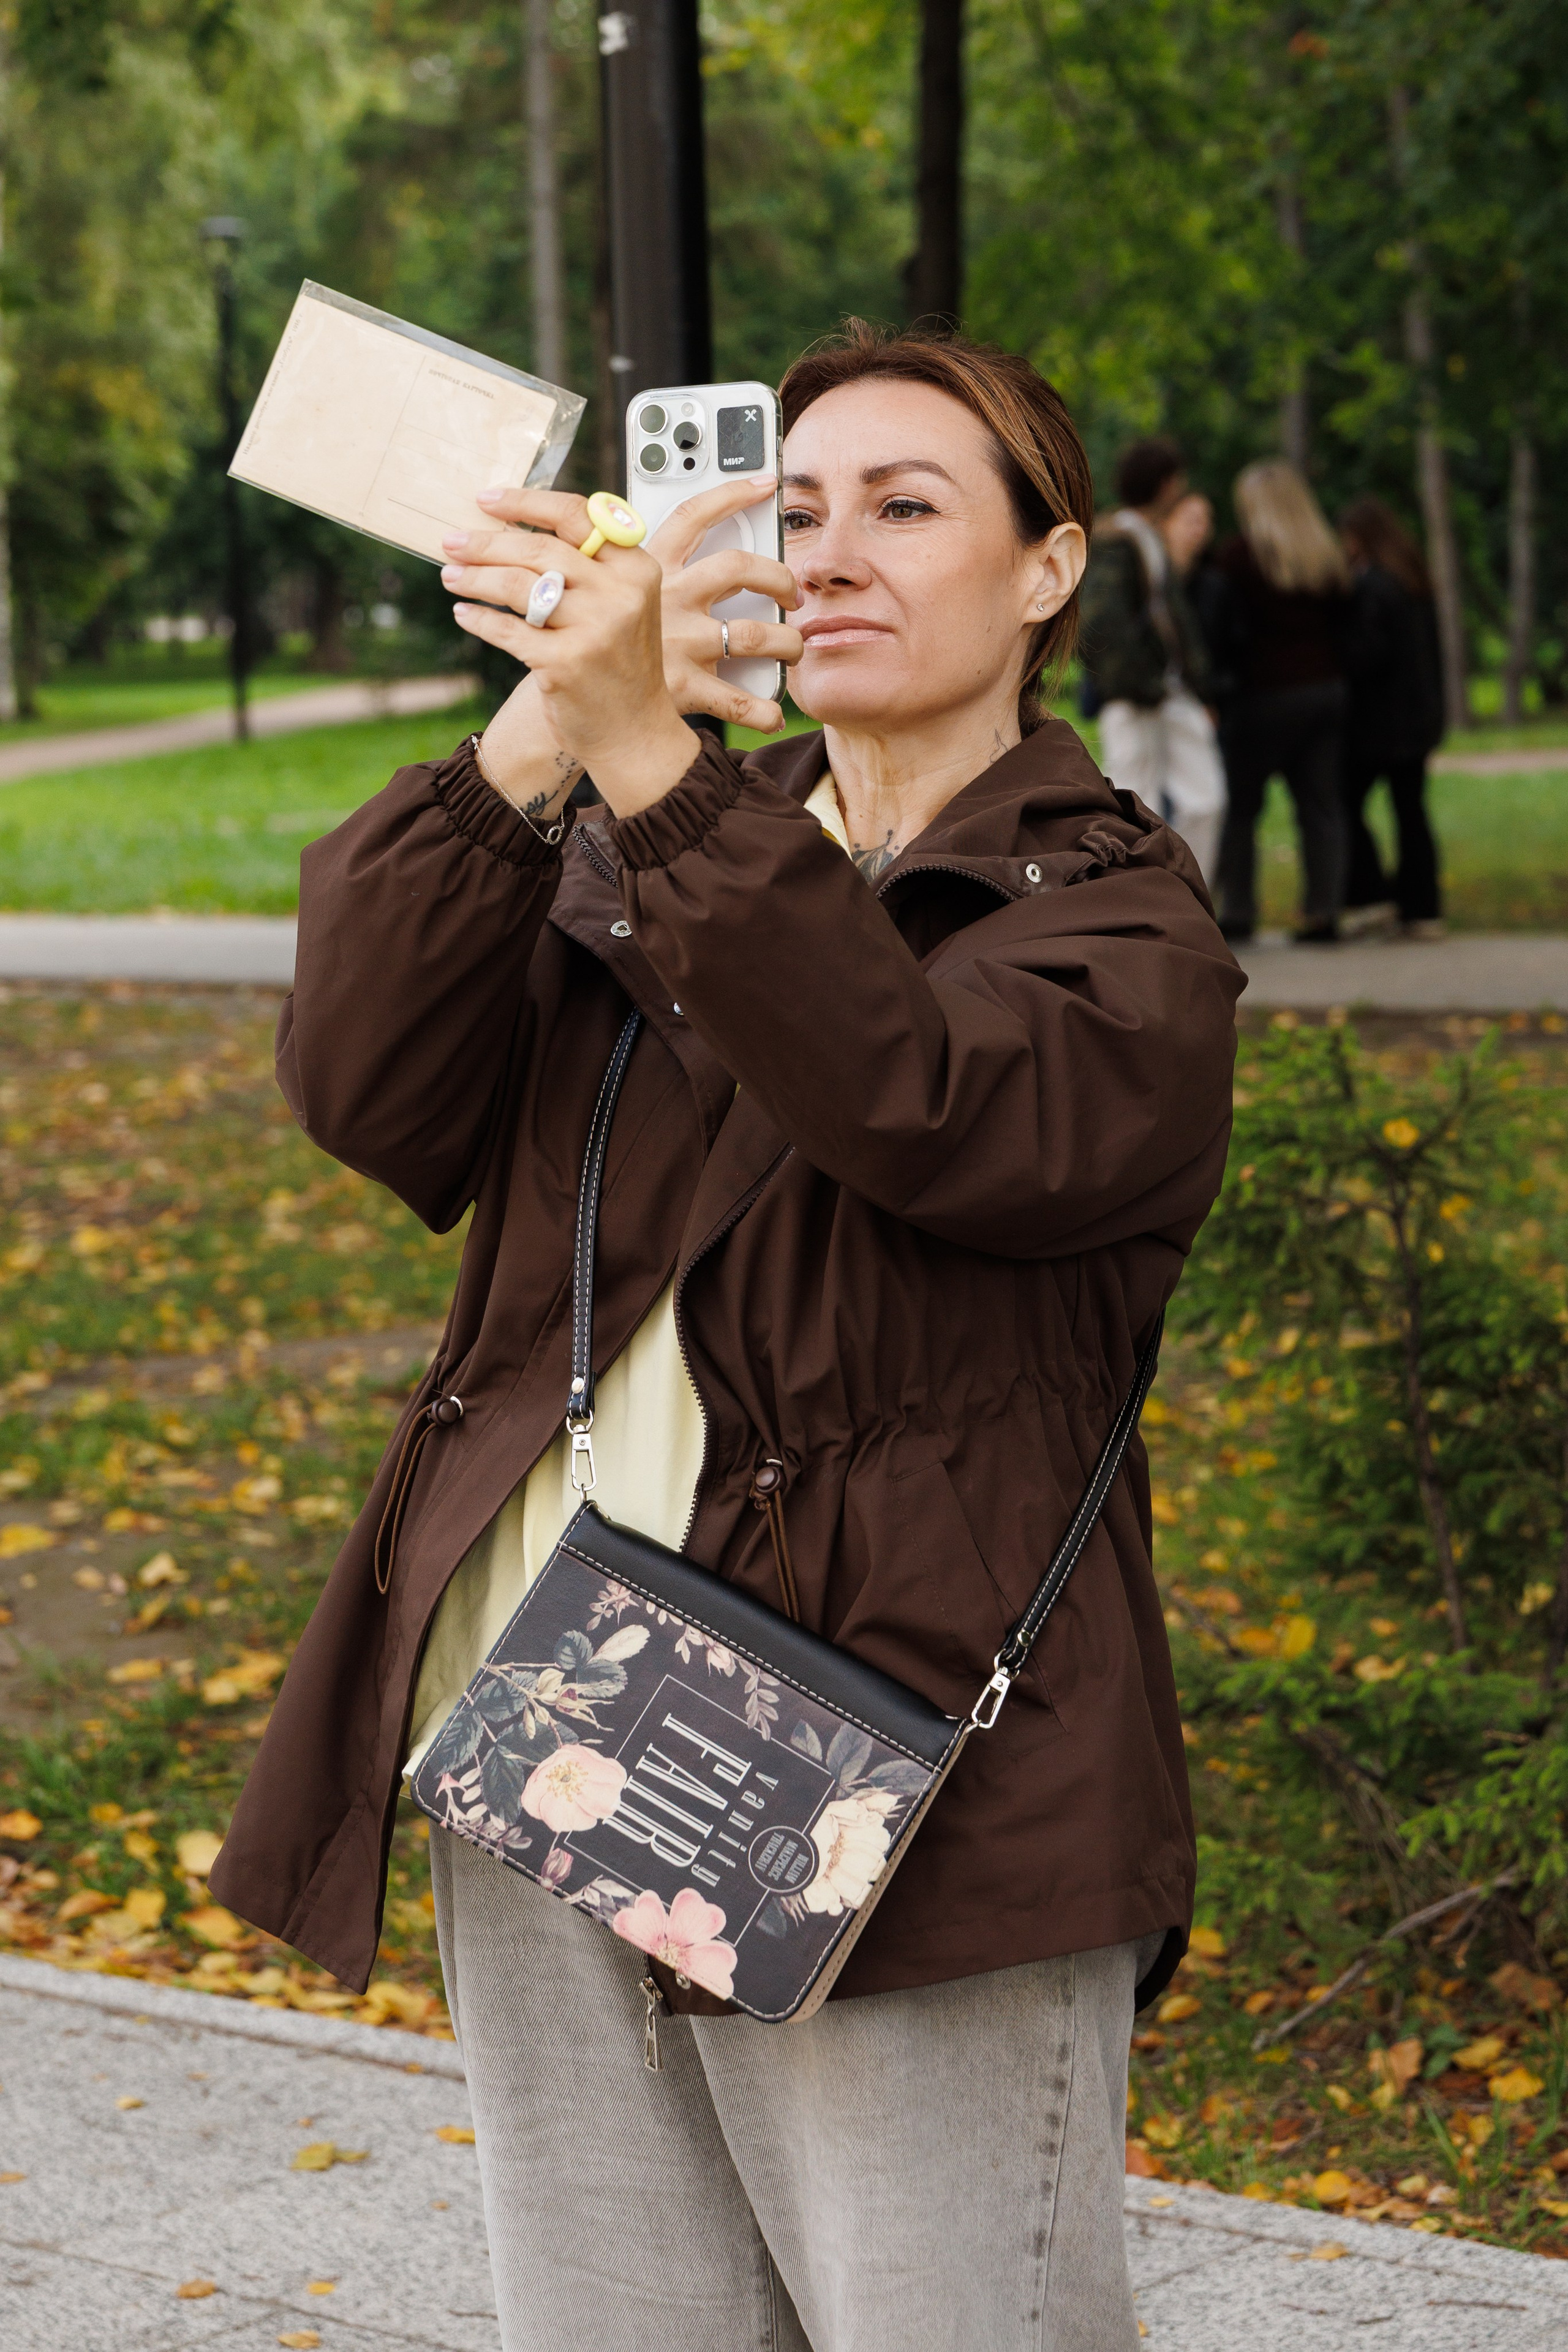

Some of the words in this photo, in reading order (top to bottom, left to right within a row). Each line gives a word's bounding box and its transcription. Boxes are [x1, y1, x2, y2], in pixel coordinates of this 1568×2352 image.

[723, 457, 745, 466] МИР
[602, 1713, 752, 1868] FAIR
[691, 1771, 779, 1887] vanity
[755, 1831, 785, 1873] THACKERAY
[768, 1839, 799, 1881] MAKEPEACE
[785, 1853, 809, 1884] WILLIAM
